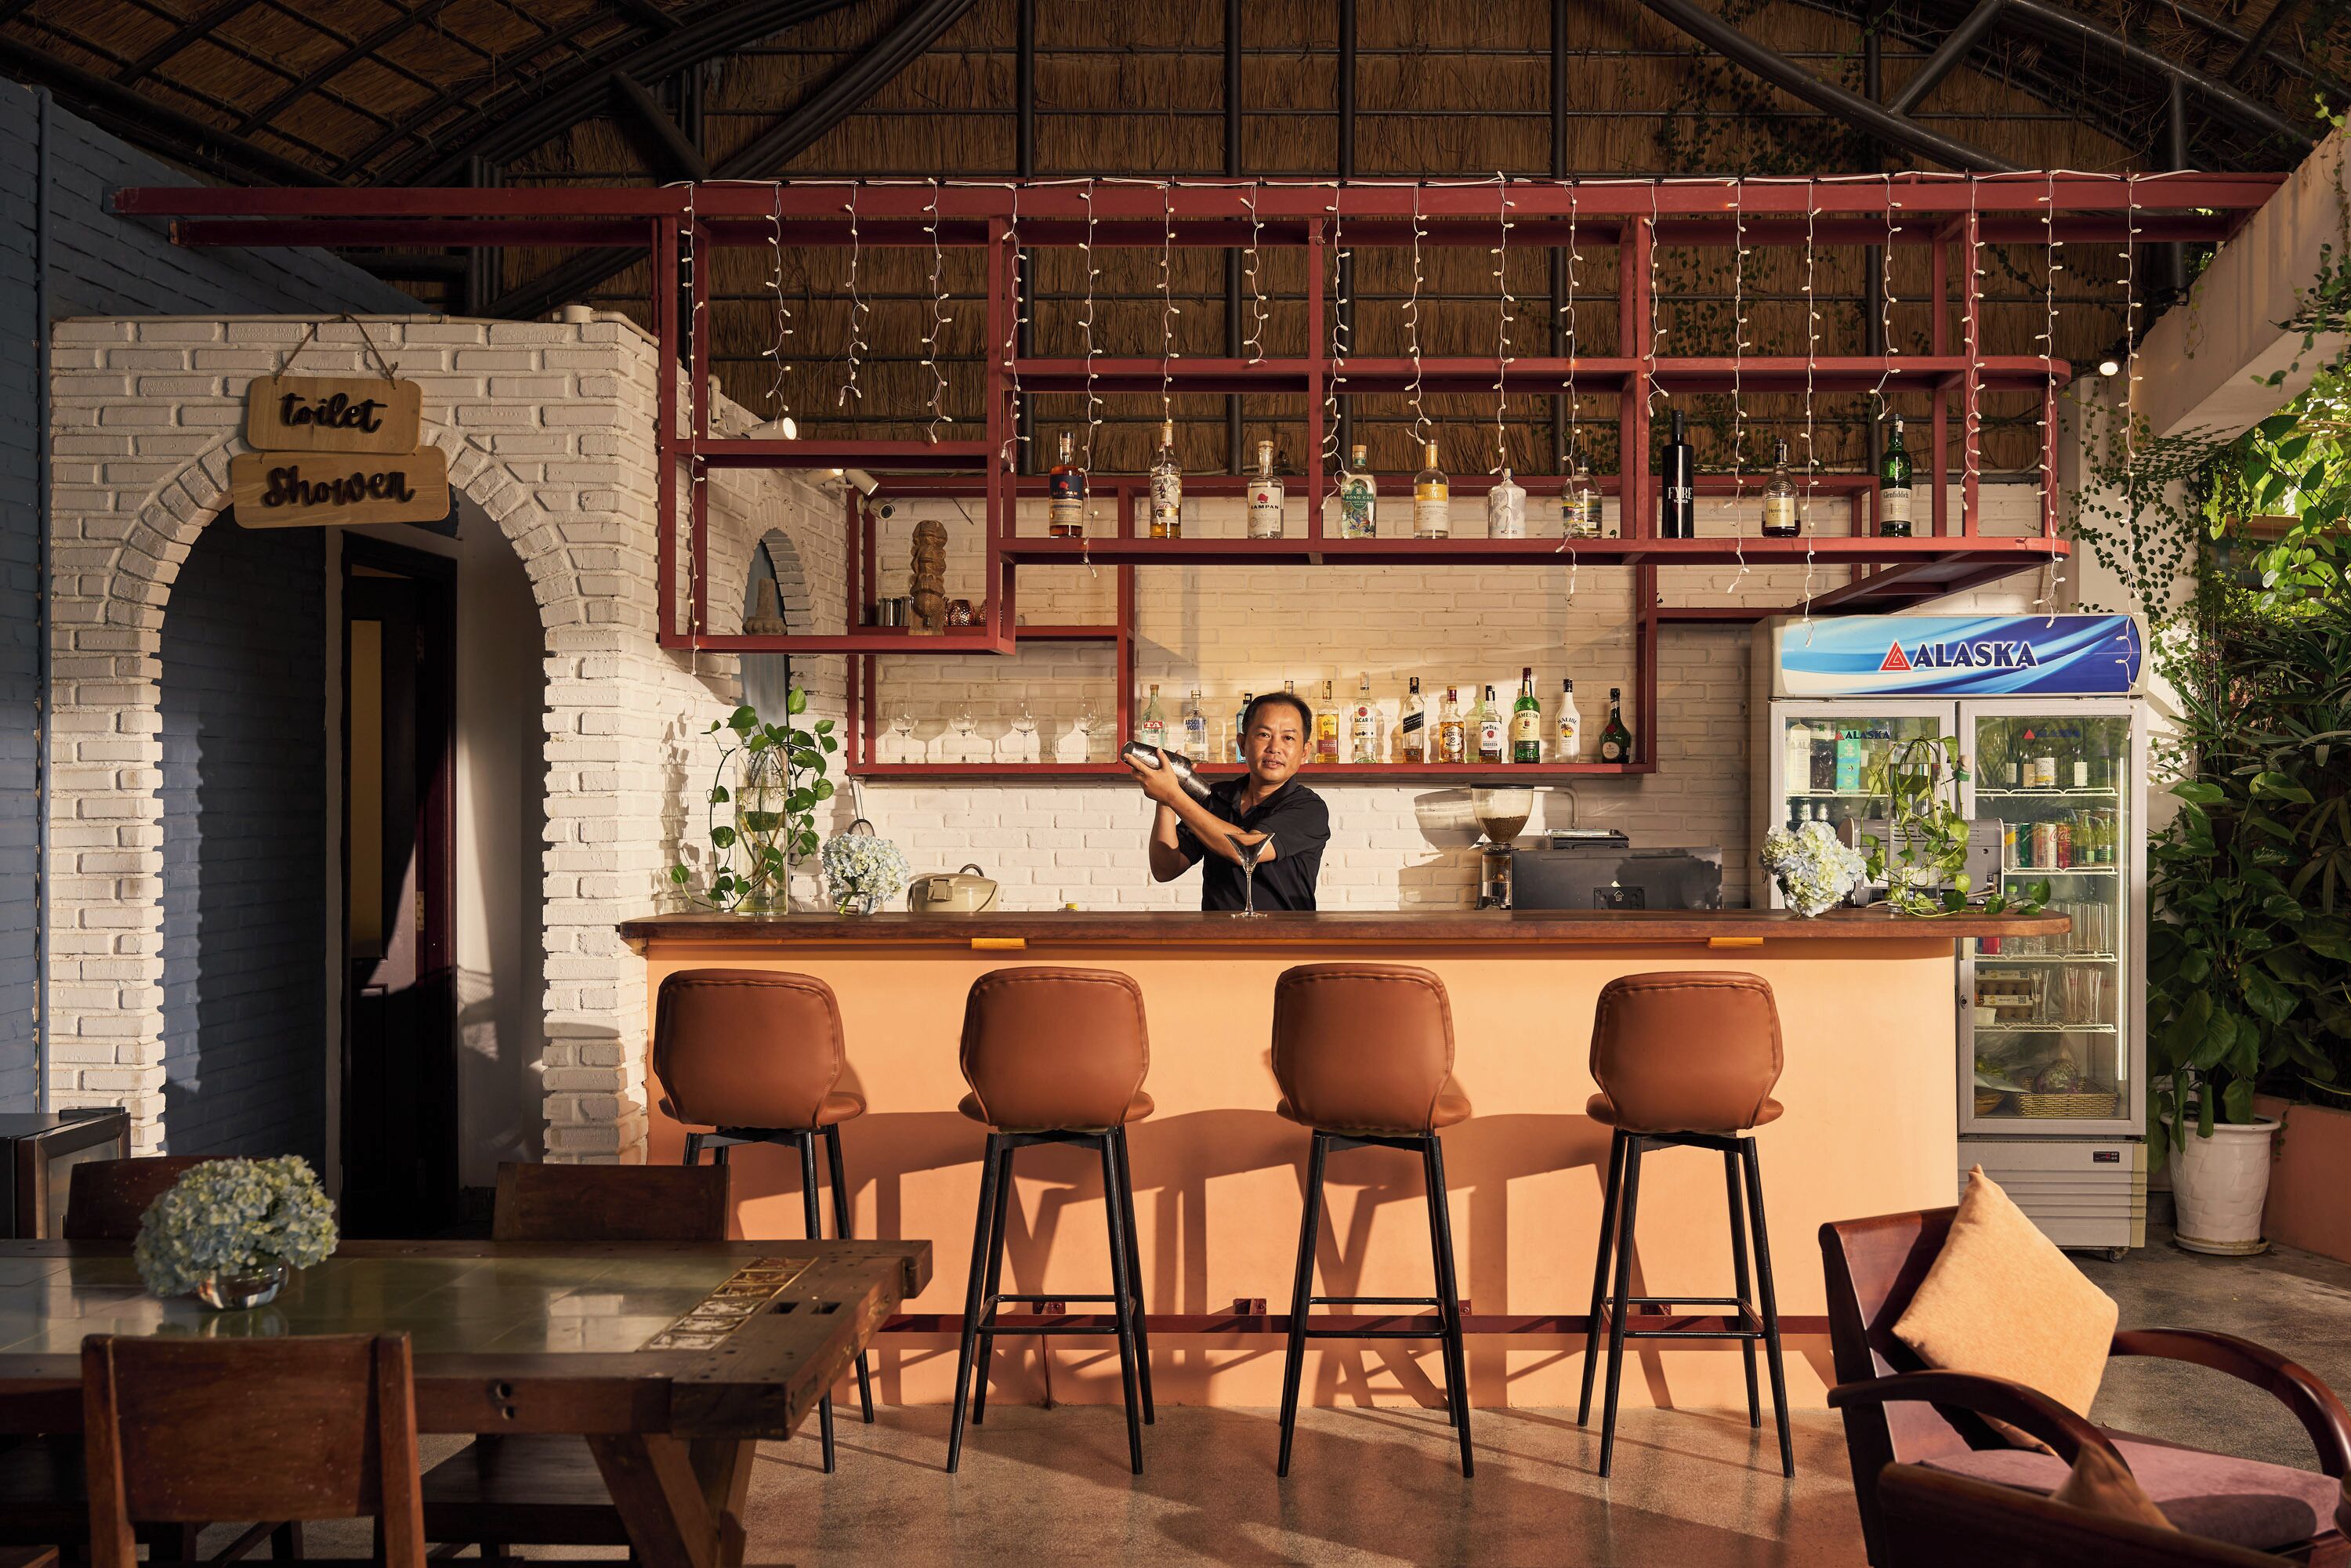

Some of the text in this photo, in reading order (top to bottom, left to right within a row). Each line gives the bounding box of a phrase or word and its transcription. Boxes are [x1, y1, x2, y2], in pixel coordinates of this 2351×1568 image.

[279, 393, 389, 434] toilet
[263, 465, 417, 508] Shower
[1913, 642, 2038, 667] ALASKA
[1516, 712, 1538, 720] JAMESON
[1845, 730, 1890, 740] ALASKA
